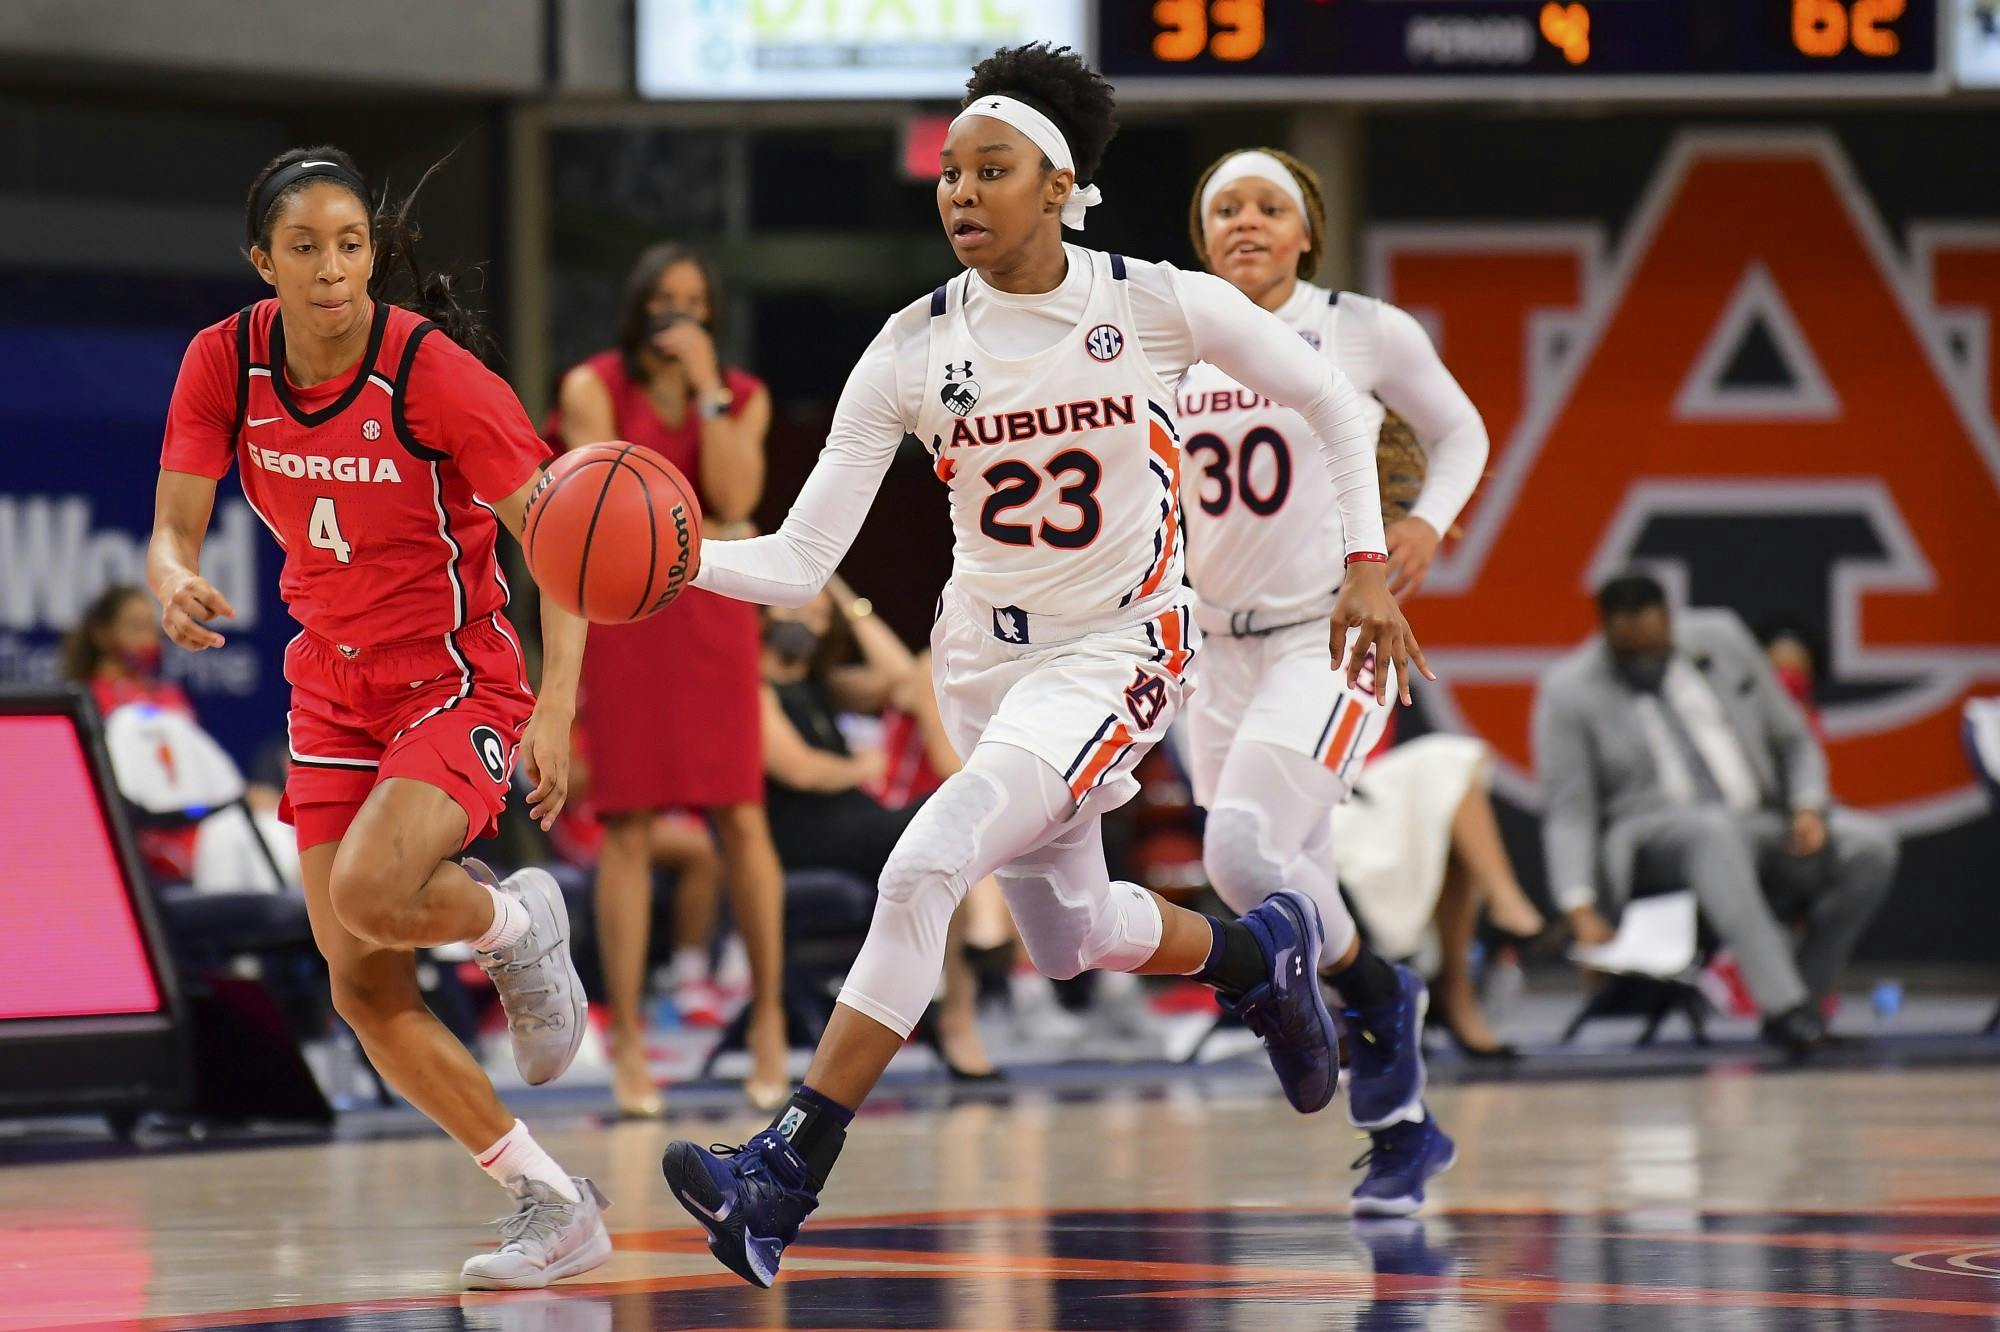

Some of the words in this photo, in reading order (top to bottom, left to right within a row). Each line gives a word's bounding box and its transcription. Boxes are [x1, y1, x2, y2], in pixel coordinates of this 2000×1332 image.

[1540, 3, 1590, 64] 4
[1087, 325, 1123, 361] SEC
[361, 418, 382, 441] SEC
[950, 394, 1136, 448] AUBURN
[247, 441, 402, 483] GEORGIA
[1185, 425, 1292, 518] 30
[979, 447, 1103, 550] 23
[308, 496, 352, 564] 4
[648, 502, 690, 614] Wilson
